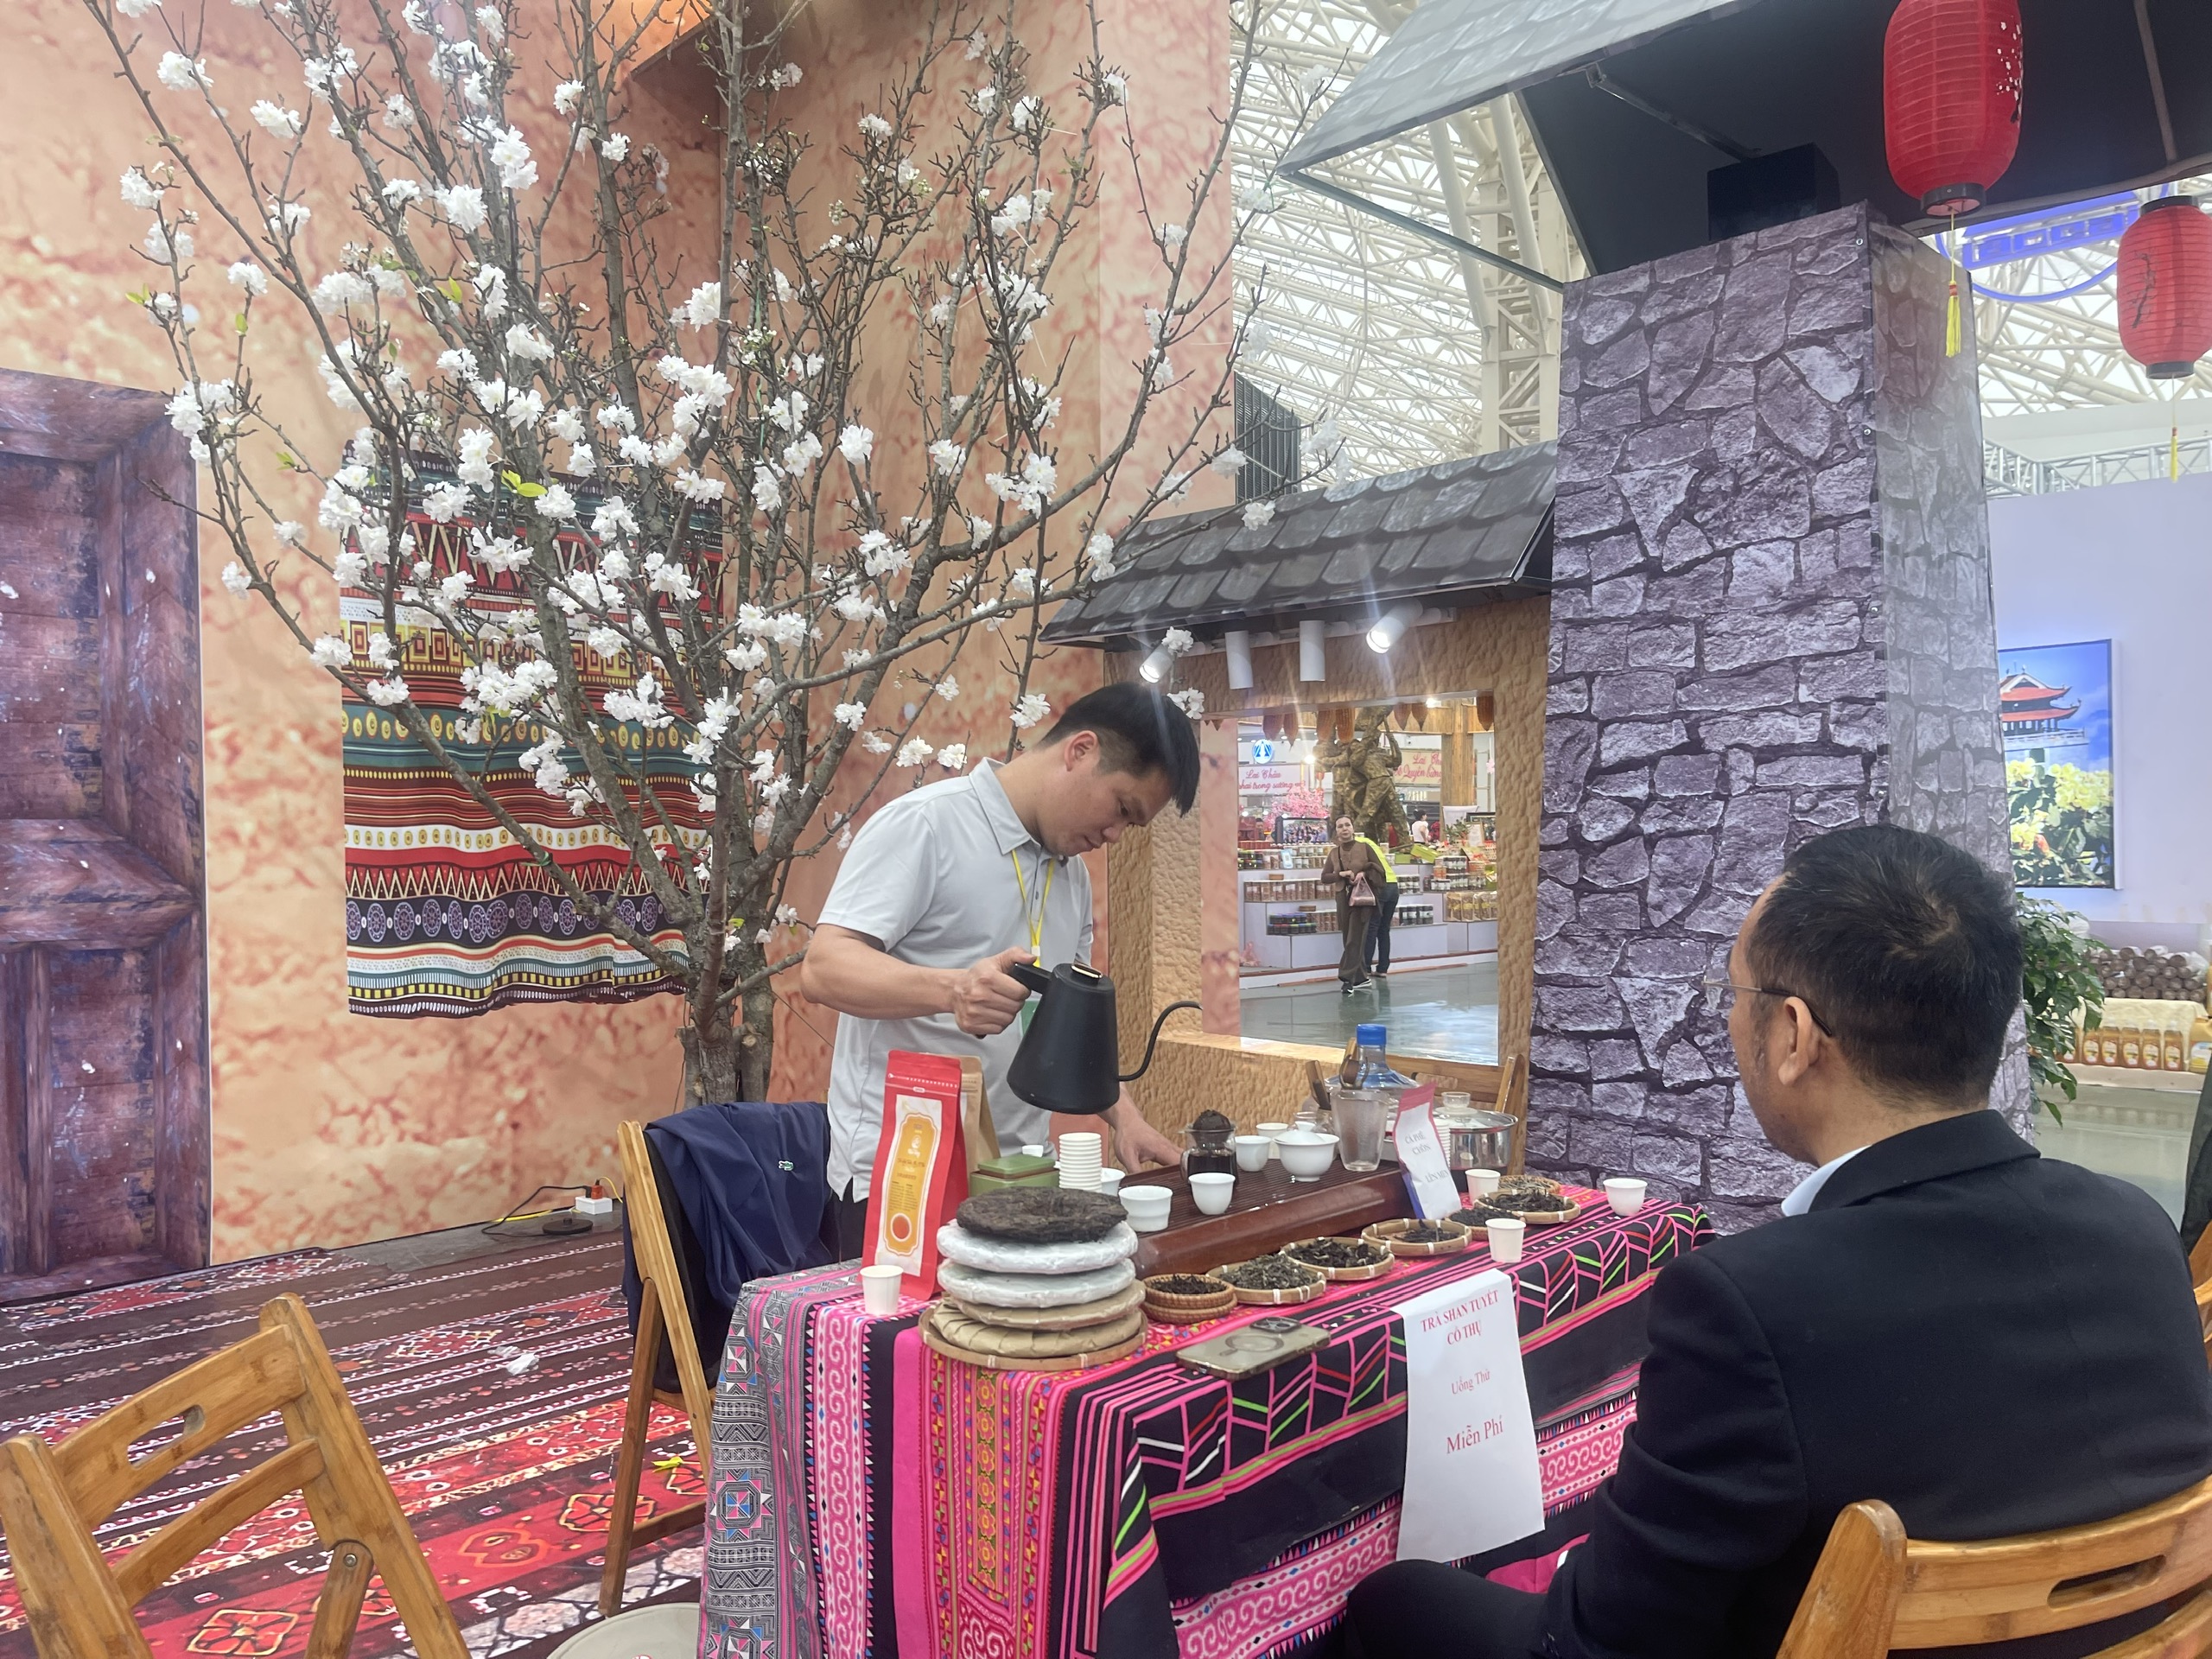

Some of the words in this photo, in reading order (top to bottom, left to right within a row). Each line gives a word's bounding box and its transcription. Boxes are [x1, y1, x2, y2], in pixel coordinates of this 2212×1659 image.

[1421, 1310, 1442, 1332] TRÀ
[1443, 1303, 1468, 1324] SHAN
[1470, 1288, 1498, 1313] TUYẾT
[1462, 1319, 1482, 1338] THỤ
[1474, 1368, 1491, 1384] Thử
[1446, 1424, 1481, 1454] Miễn
[1484, 1414, 1503, 1440] Phí
